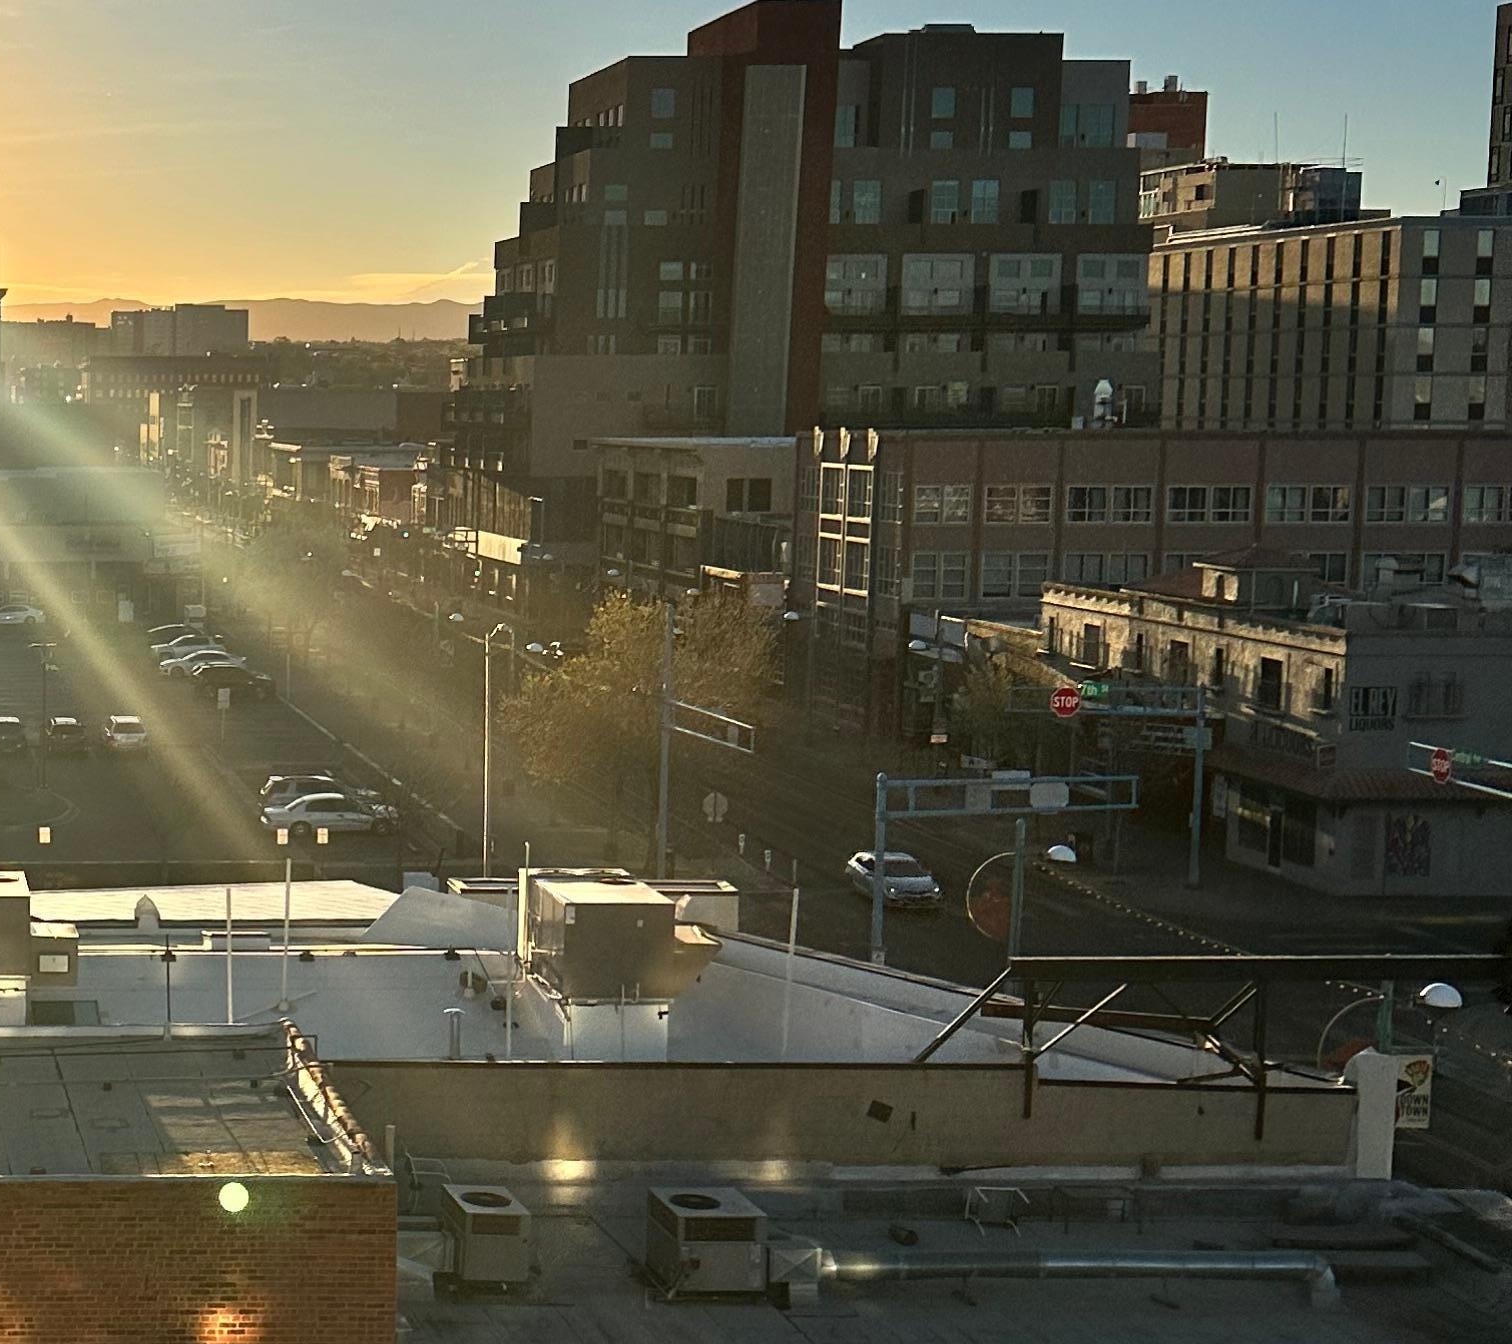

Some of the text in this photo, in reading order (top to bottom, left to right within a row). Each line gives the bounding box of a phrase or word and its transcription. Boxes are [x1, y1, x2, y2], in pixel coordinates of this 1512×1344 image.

[1053, 696, 1079, 708] STOP
[1351, 688, 1397, 716] EL REY
[1349, 718, 1395, 732] LIQUORS
